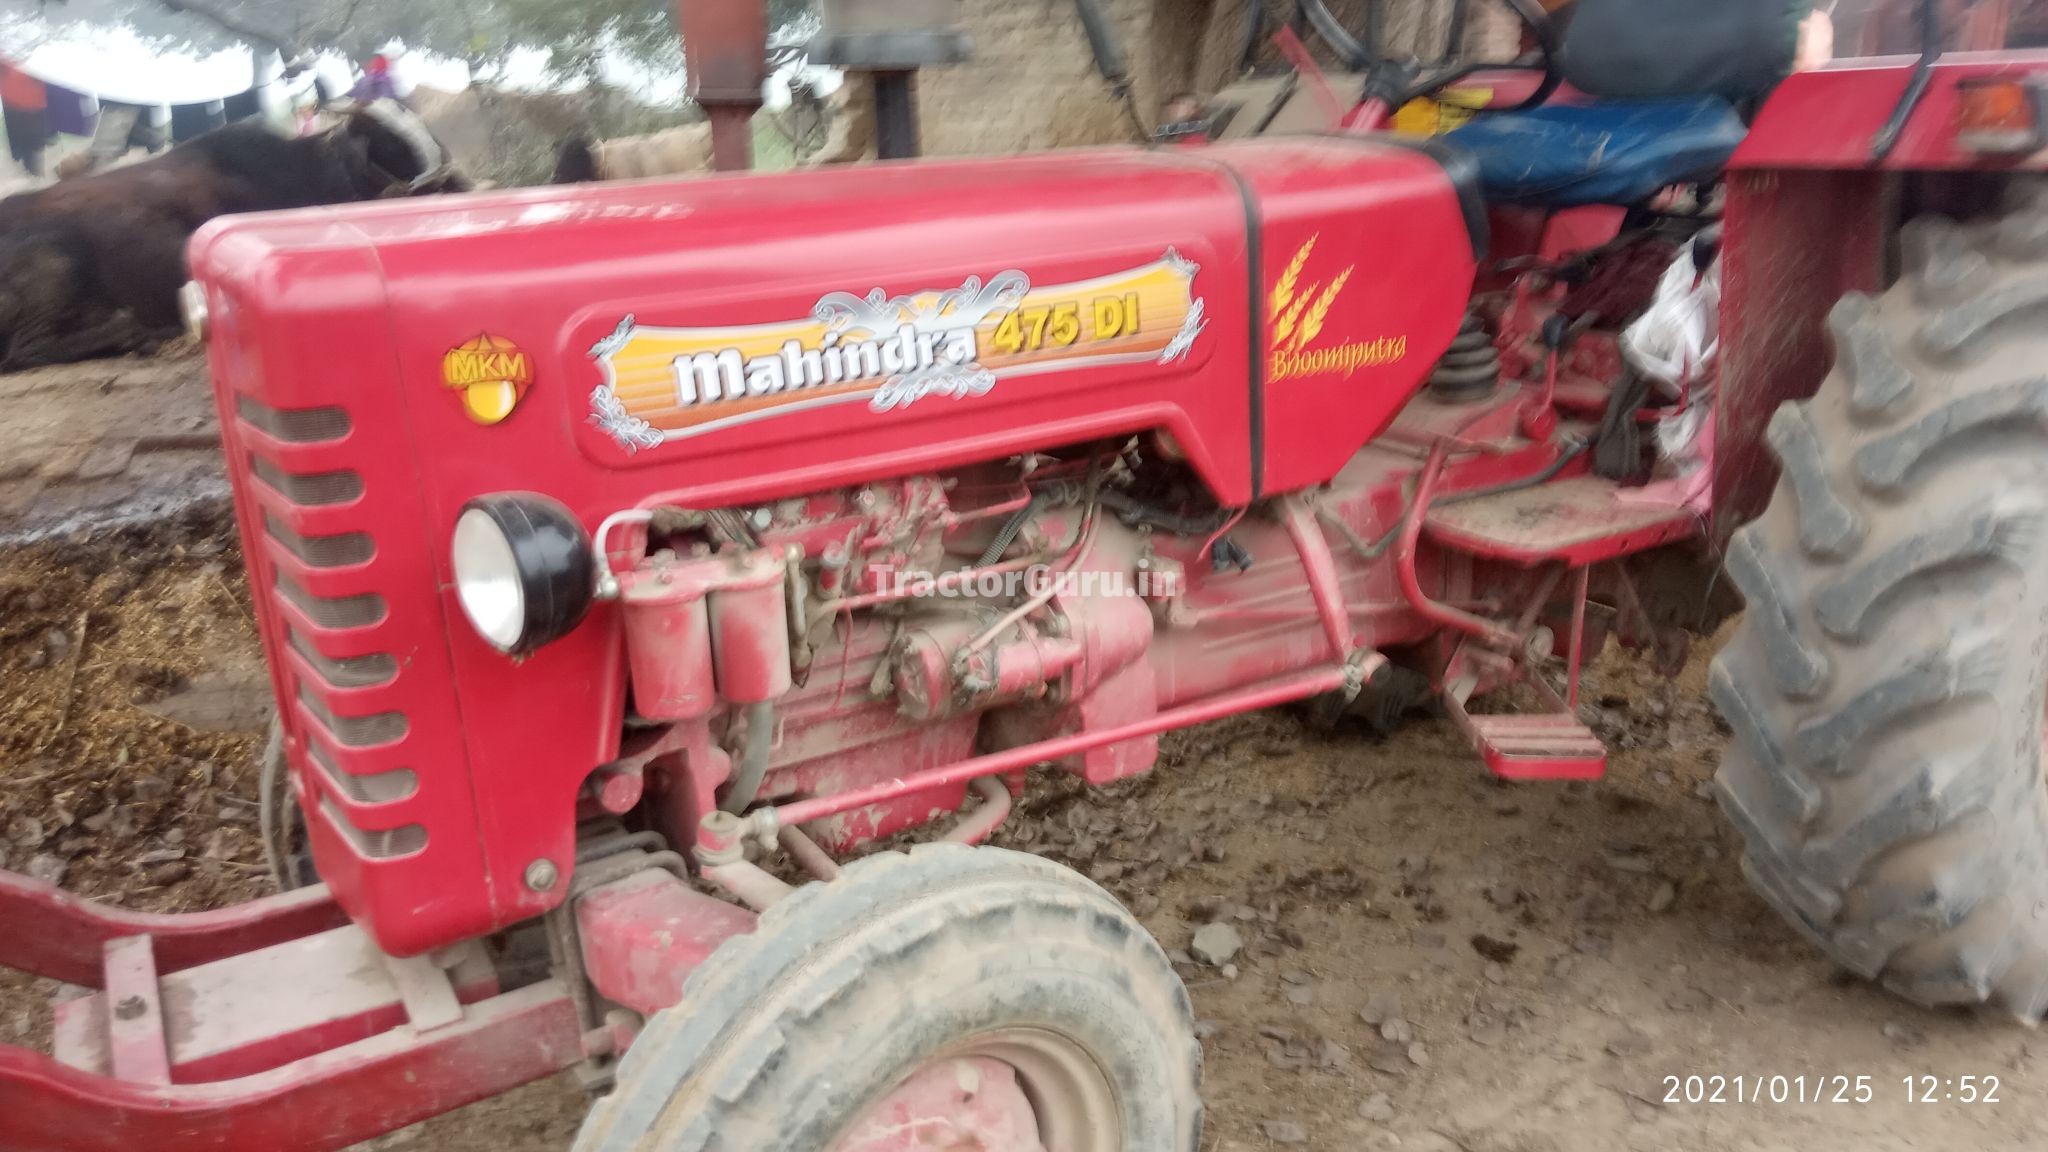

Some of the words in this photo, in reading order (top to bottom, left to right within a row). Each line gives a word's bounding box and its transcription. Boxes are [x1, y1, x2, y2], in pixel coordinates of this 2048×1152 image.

[449, 350, 527, 382] MKM
[673, 323, 978, 406] Mahindra
[994, 301, 1079, 353] 475
[1093, 292, 1138, 340] DI
[1269, 335, 1407, 382] Bhoomiputra
